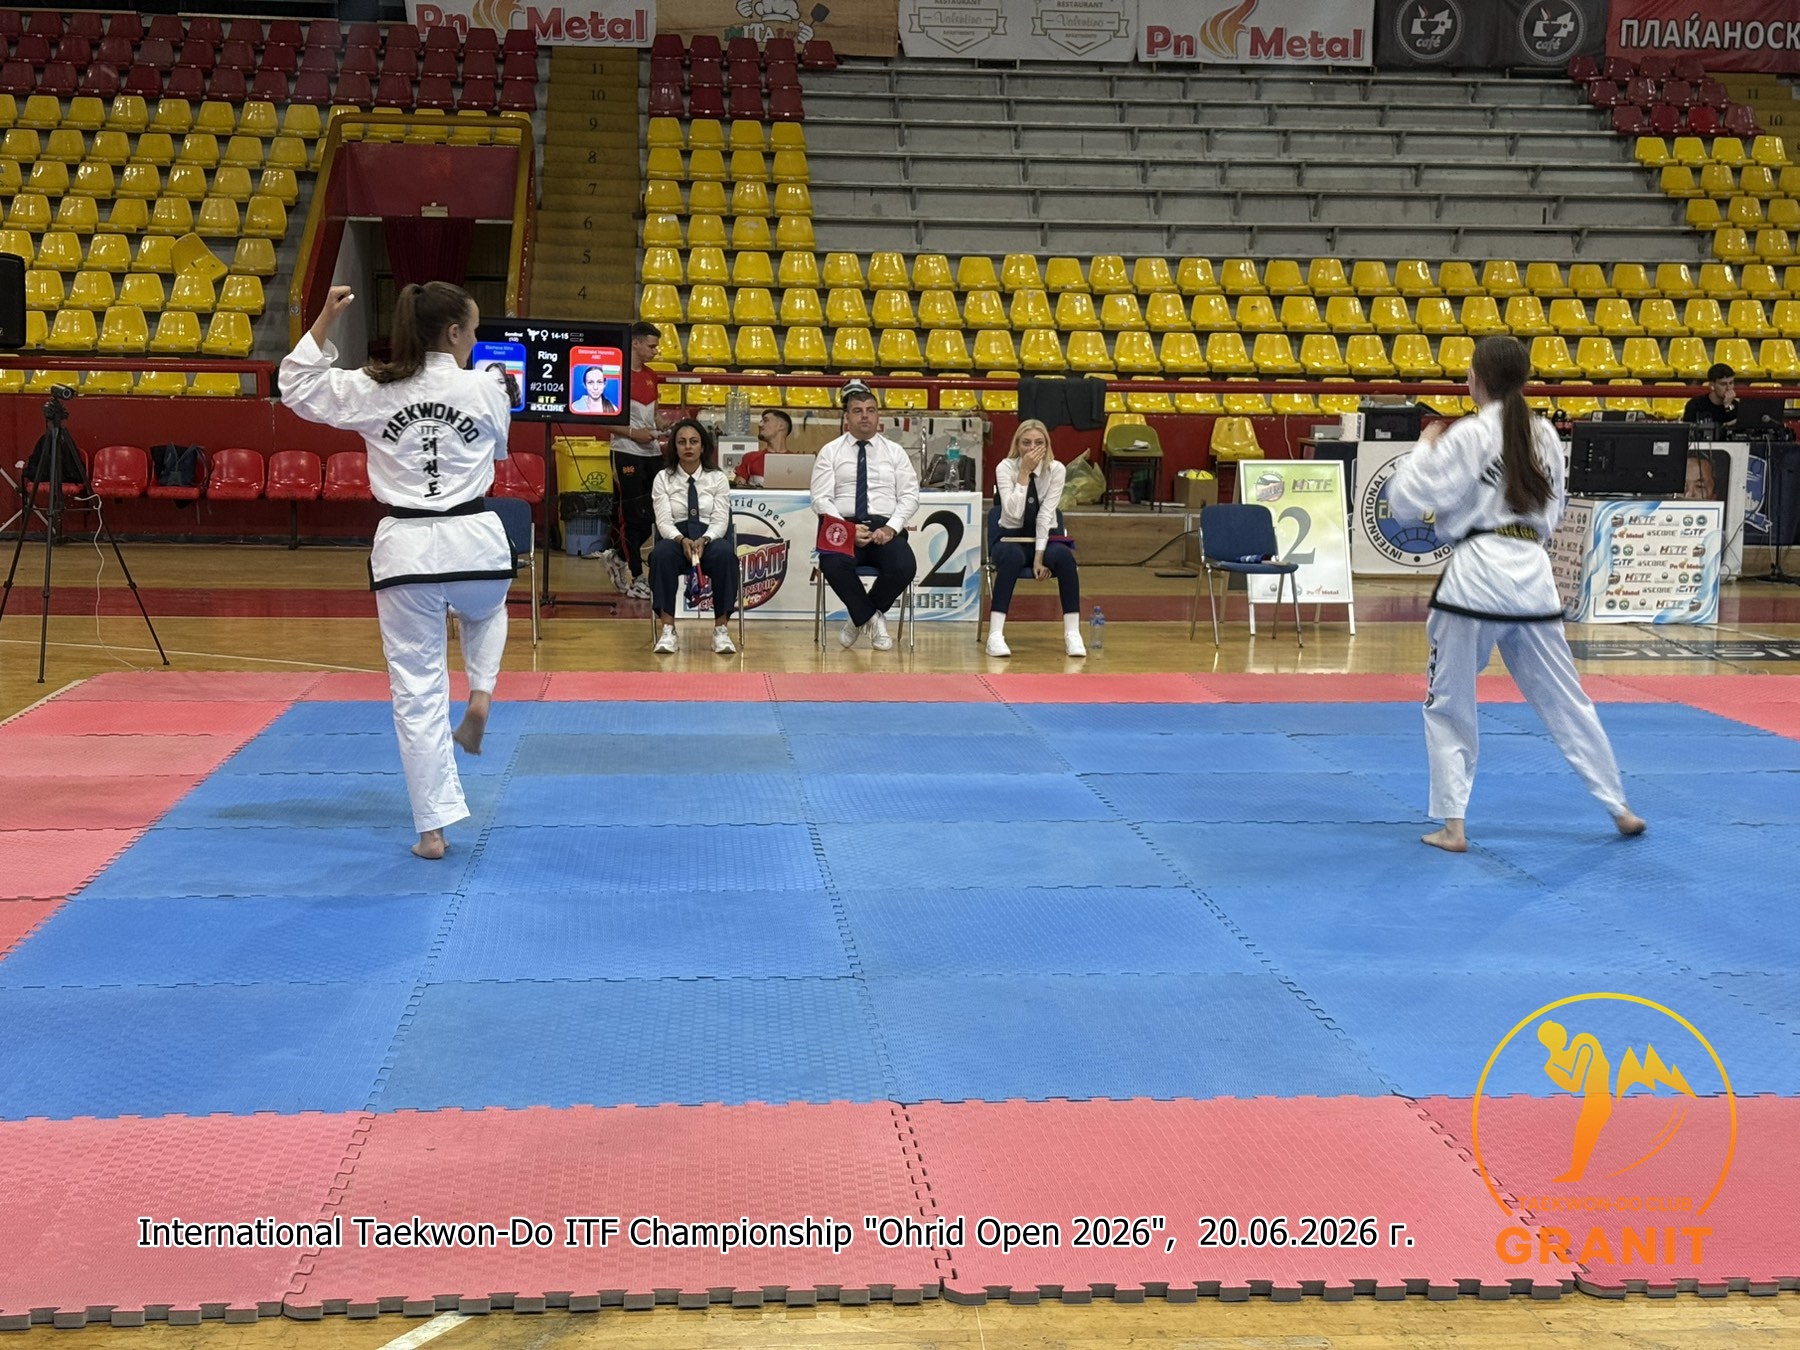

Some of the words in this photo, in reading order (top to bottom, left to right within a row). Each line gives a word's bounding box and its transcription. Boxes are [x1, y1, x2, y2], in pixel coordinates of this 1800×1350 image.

[416, 4, 467, 35] Pn
[526, 7, 646, 40] Metal
[1147, 25, 1196, 57] Pn
[1251, 27, 1364, 59] Metal
[592, 89, 606, 101] 10
[588, 150, 597, 164] 8
[588, 183, 597, 195] 7
[583, 215, 593, 230] 6
[582, 249, 591, 265] 5
[577, 285, 588, 300] 4
[537, 351, 558, 362] Ring
[542, 364, 553, 379] 2
[529, 382, 565, 393] #21024
[382, 402, 480, 444] TAEKWON-DO
[421, 425, 440, 435] ITF
[758, 503, 785, 528] Open
[1365, 474, 1403, 560] INTERNATIONAL
[1277, 506, 1316, 565] 2
[918, 510, 967, 588] 2
